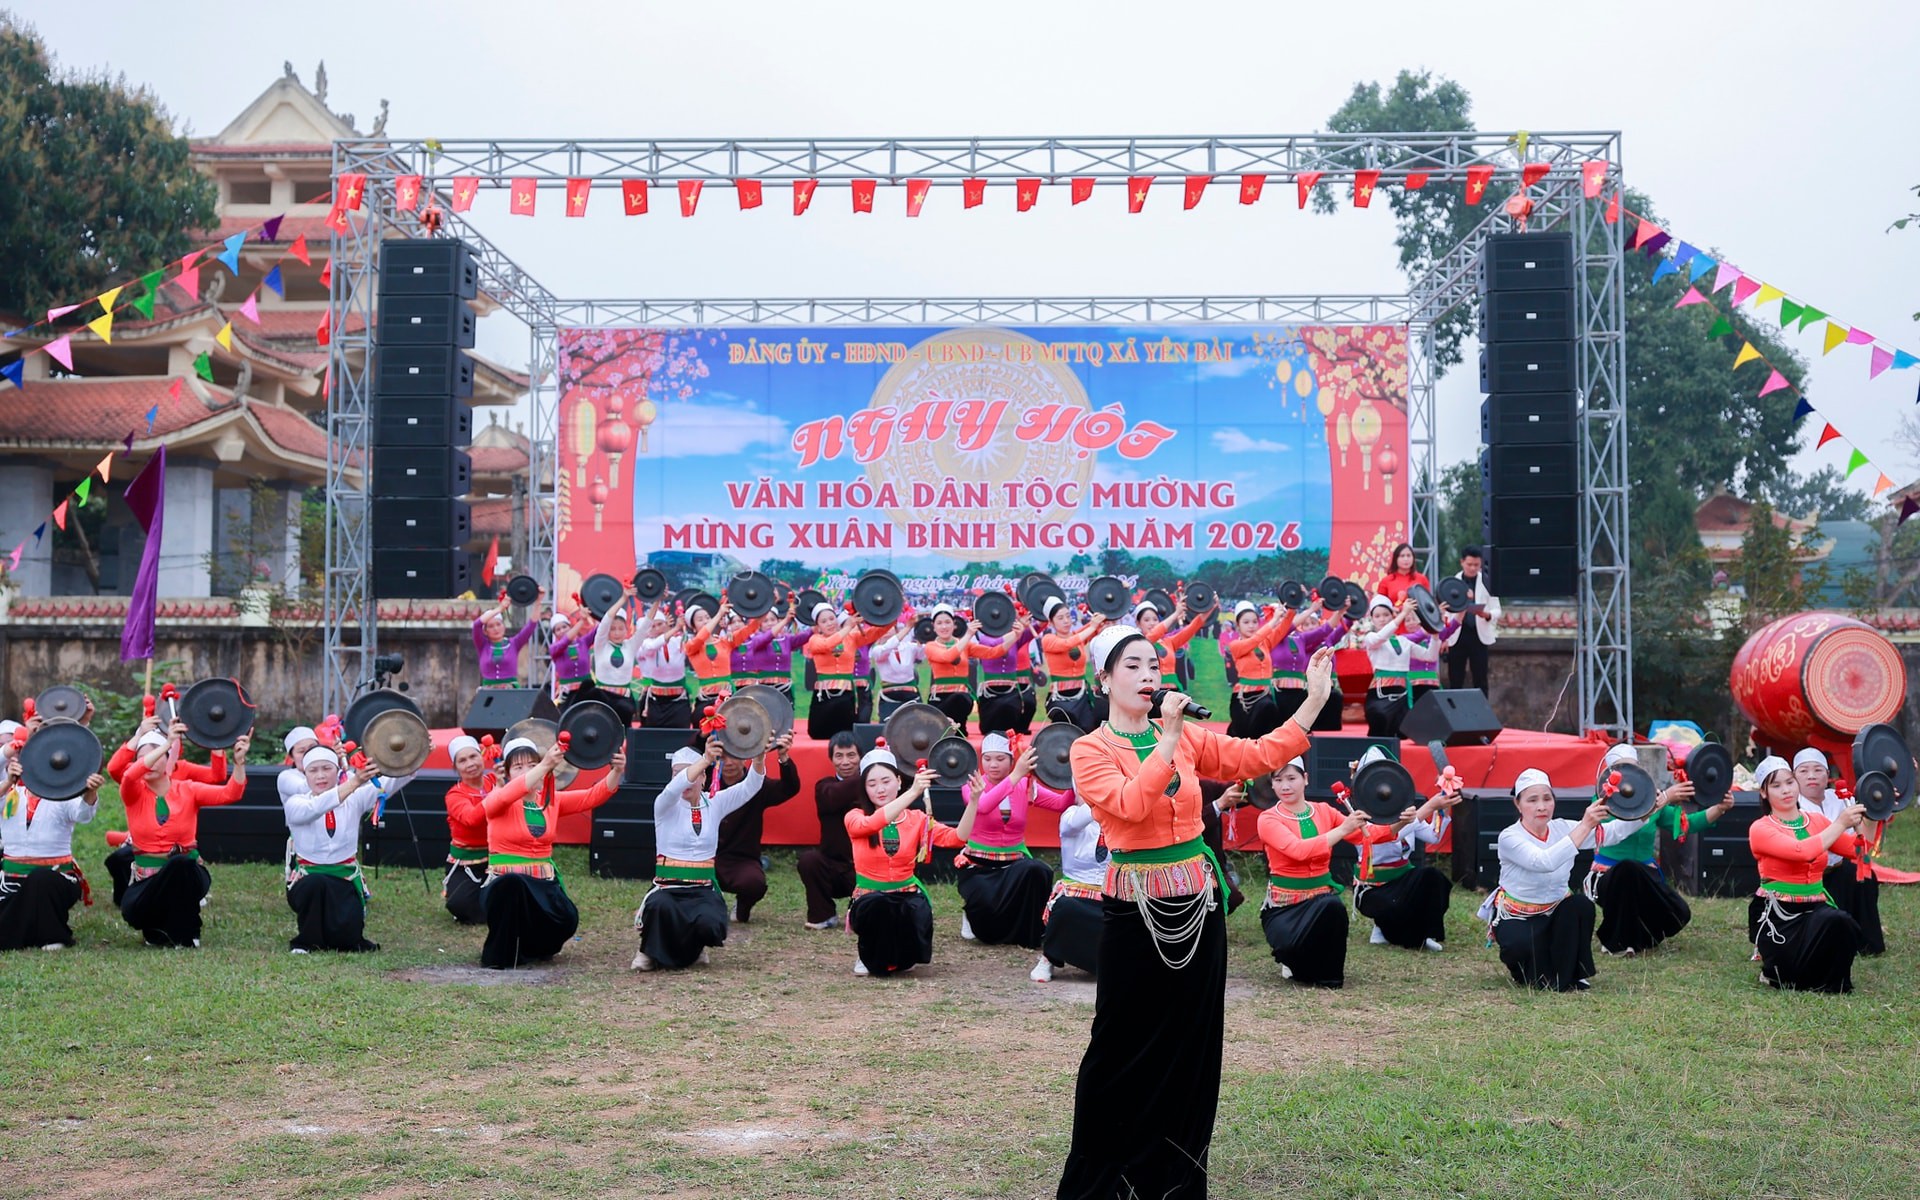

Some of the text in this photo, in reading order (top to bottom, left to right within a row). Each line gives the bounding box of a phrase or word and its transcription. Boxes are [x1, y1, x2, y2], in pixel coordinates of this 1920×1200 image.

[729, 337, 792, 364] ĐẢNG
[797, 337, 828, 364] ỦY
[844, 342, 907, 364] HĐND
[926, 342, 986, 363] UBND
[1003, 342, 1034, 363] UB
[1039, 342, 1104, 367] MTTQ
[1107, 337, 1140, 363] XÃ
[1143, 336, 1188, 363] YÊN
[1194, 336, 1234, 363] BÀI
[793, 390, 1009, 467] NGÀY
[727, 476, 1236, 513] VĂN HÓA DÂN TỘC MƯỜNG
[663, 517, 1301, 555] MỪNG XUÂN BÍNH NGỌ NĂM 2026
[826, 574, 857, 589] Yên
